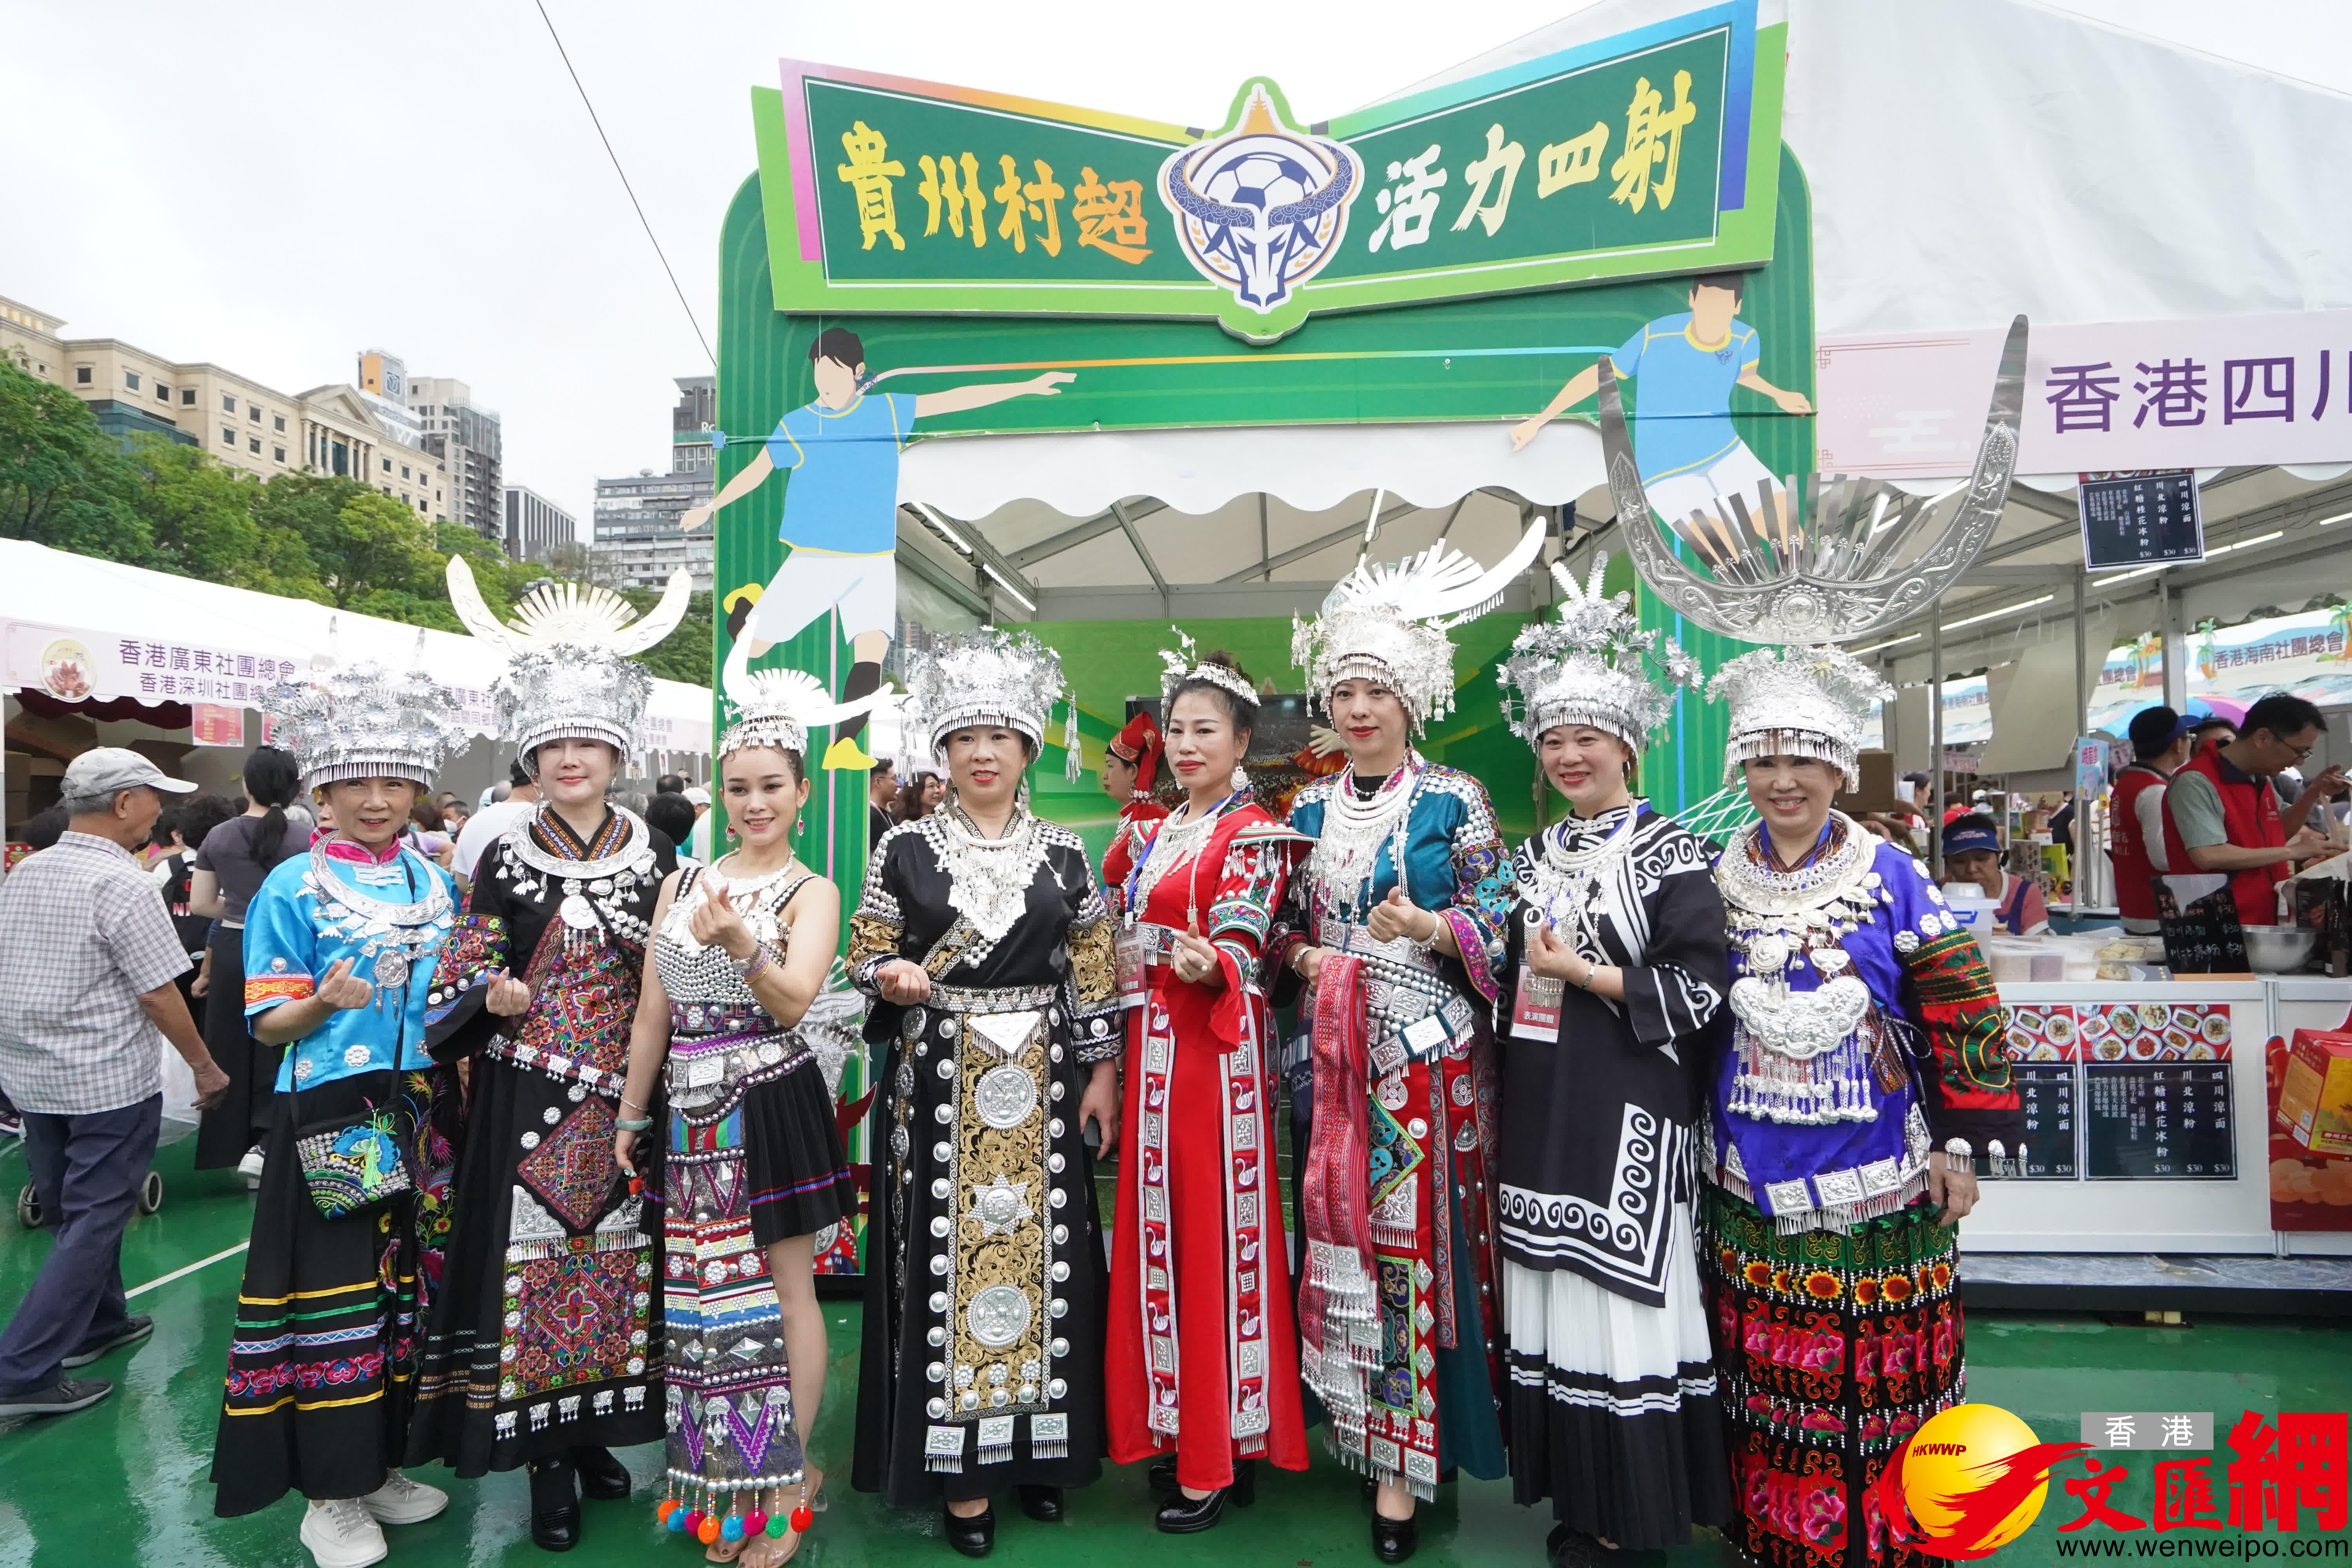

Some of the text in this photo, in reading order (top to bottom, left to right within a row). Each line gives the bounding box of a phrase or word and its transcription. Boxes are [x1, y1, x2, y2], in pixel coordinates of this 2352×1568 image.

[1368, 69, 1696, 253] 活力四射
[838, 120, 1154, 265] 貴州村超
[2215, 631, 2343, 670] 香港海南社團總會
[1523, 1011, 1554, 1024] 表演團體
[2029, 1165, 2045, 1173] $30
[2056, 1165, 2072, 1173] $30
[2154, 1164, 2171, 1173] $30
[2186, 1164, 2203, 1173] $30
[2214, 1164, 2230, 1173] $30
